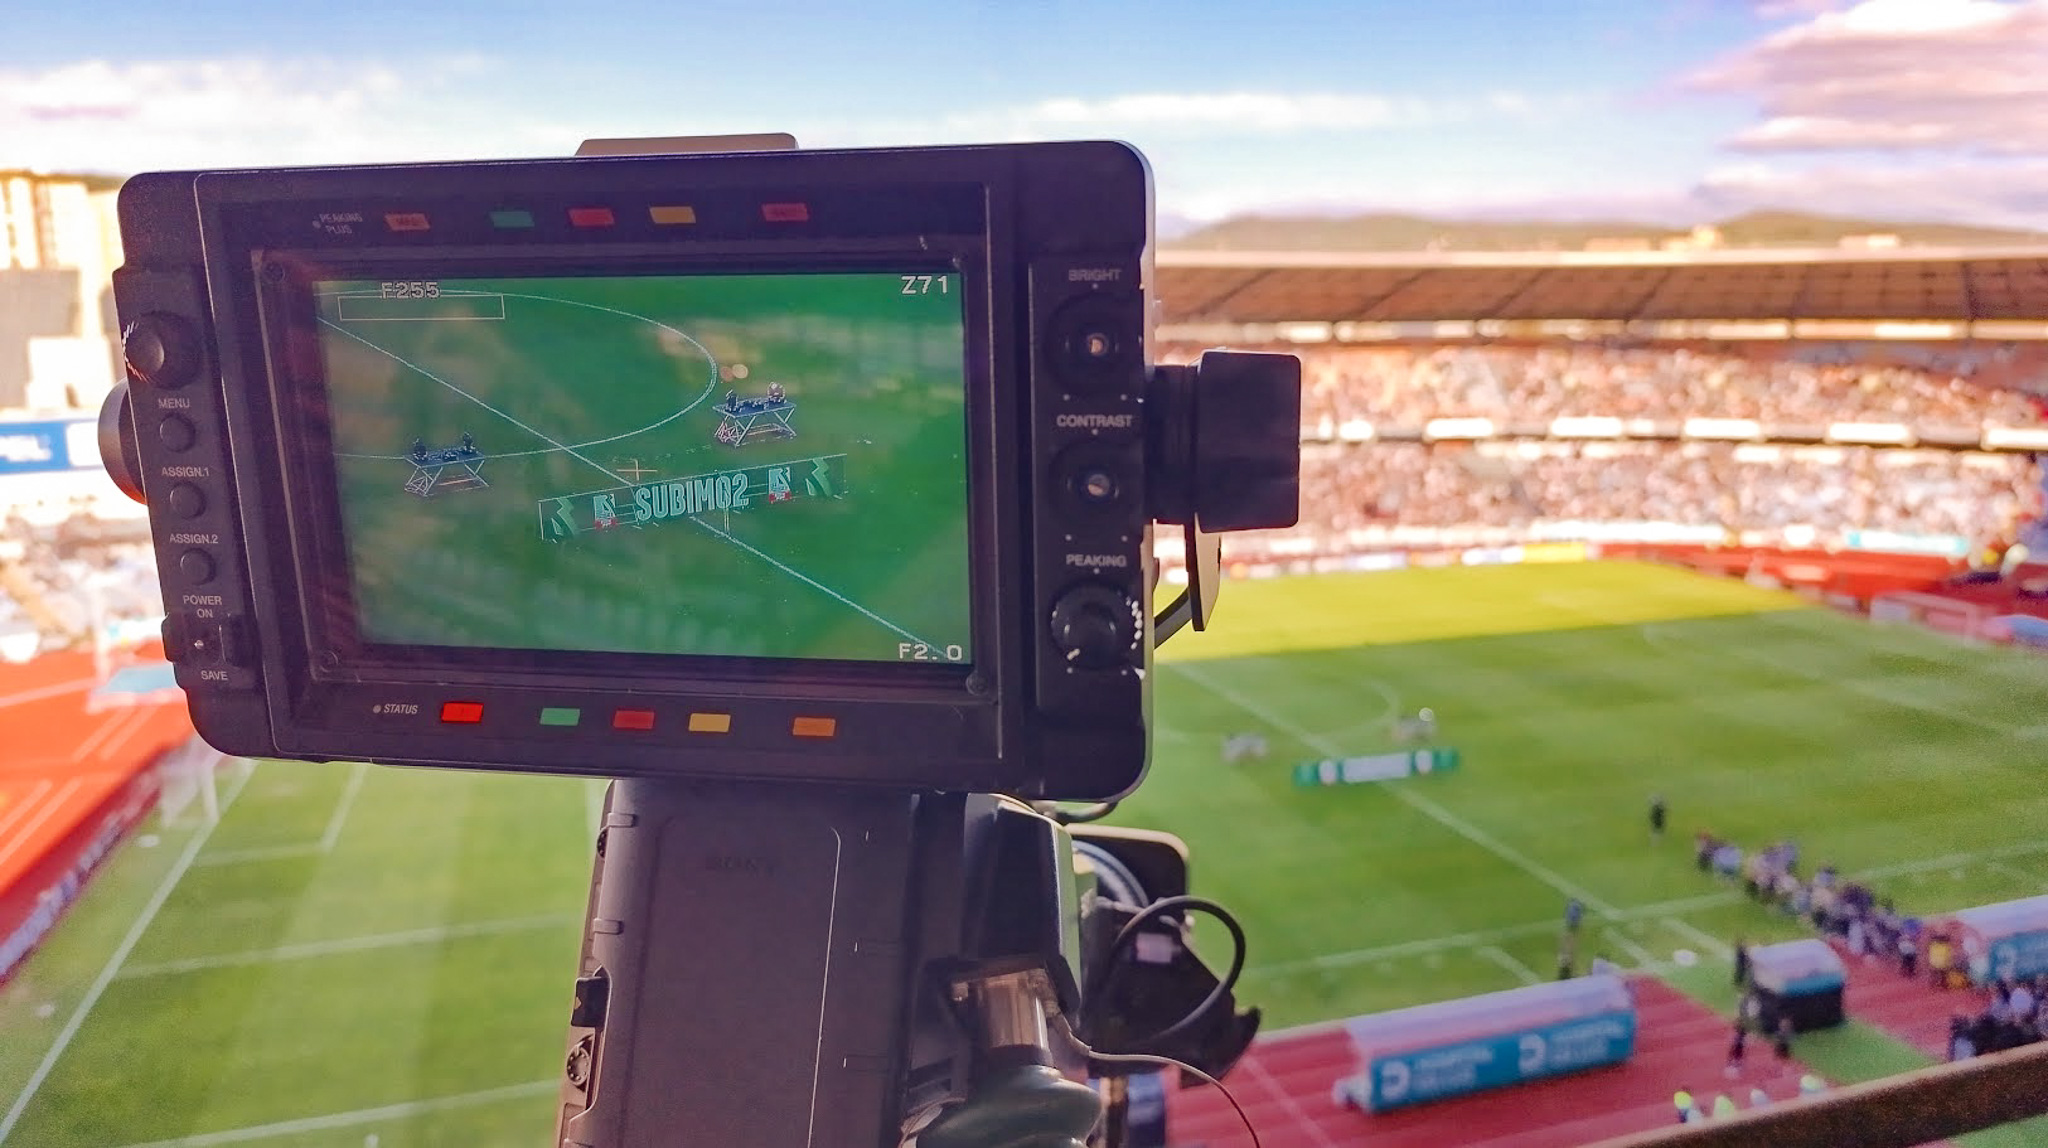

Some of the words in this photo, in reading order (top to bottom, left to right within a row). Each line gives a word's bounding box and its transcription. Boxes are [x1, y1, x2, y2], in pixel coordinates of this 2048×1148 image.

[325, 225, 352, 234] PLUS
[1068, 268, 1122, 281] BRIGHT
[901, 275, 948, 294] Z71
[381, 282, 440, 299] F255
[158, 398, 190, 408] MENU
[1056, 414, 1132, 428] CONTRAST
[161, 466, 210, 477] ASSIGN.1
[169, 533, 219, 544] ASSIGN.2
[1065, 553, 1127, 567] PEAKING
[182, 595, 222, 606] POWER
[196, 608, 213, 618] ON
[201, 670, 228, 680] SAVE
[383, 703, 419, 715] STATUS
